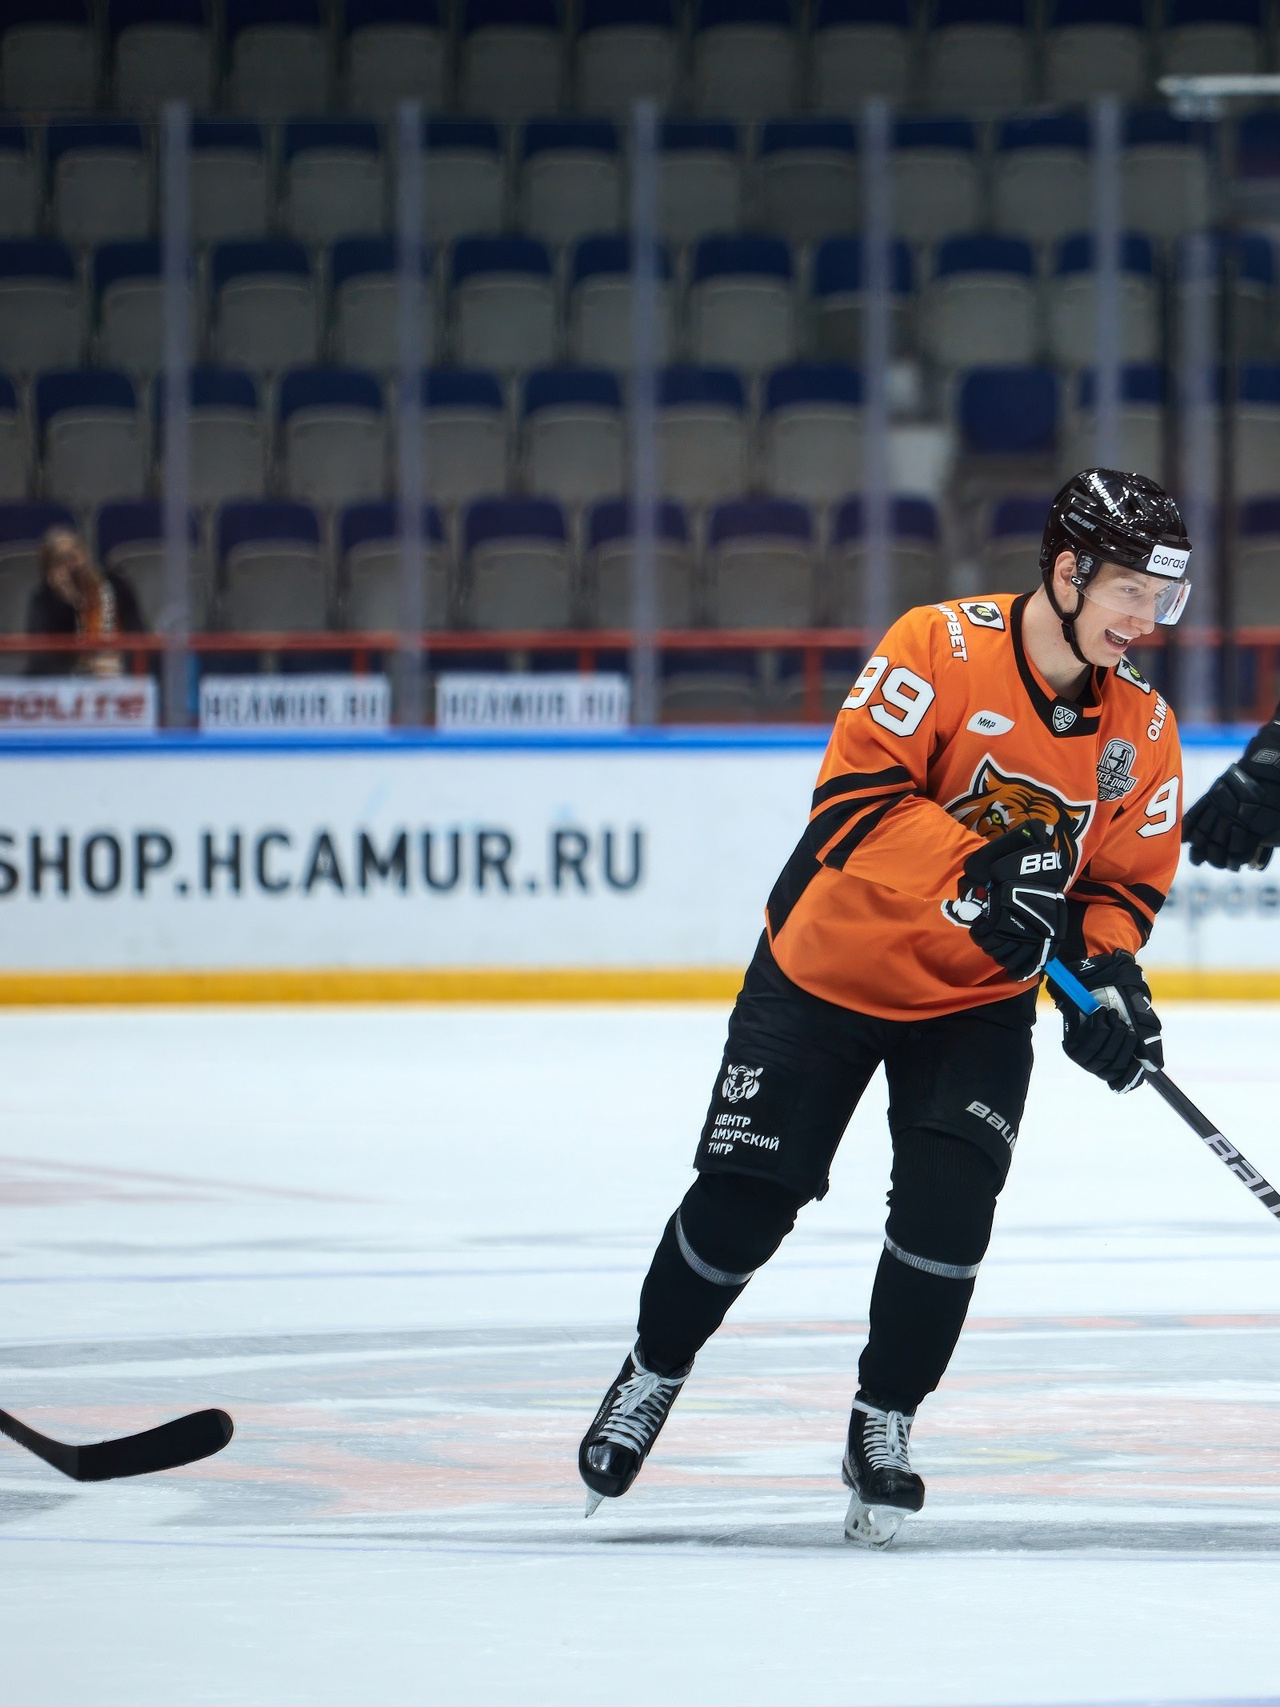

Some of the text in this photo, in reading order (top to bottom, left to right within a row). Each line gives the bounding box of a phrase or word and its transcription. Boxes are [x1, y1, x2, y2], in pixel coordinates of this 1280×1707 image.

[1152, 554, 1185, 569] согаз
[841, 655, 936, 737] 99
[714, 1113, 752, 1129] ЦЕНТР
[711, 1129, 780, 1152] АМУРСКИЙ
[707, 1142, 735, 1156] ТИГР
